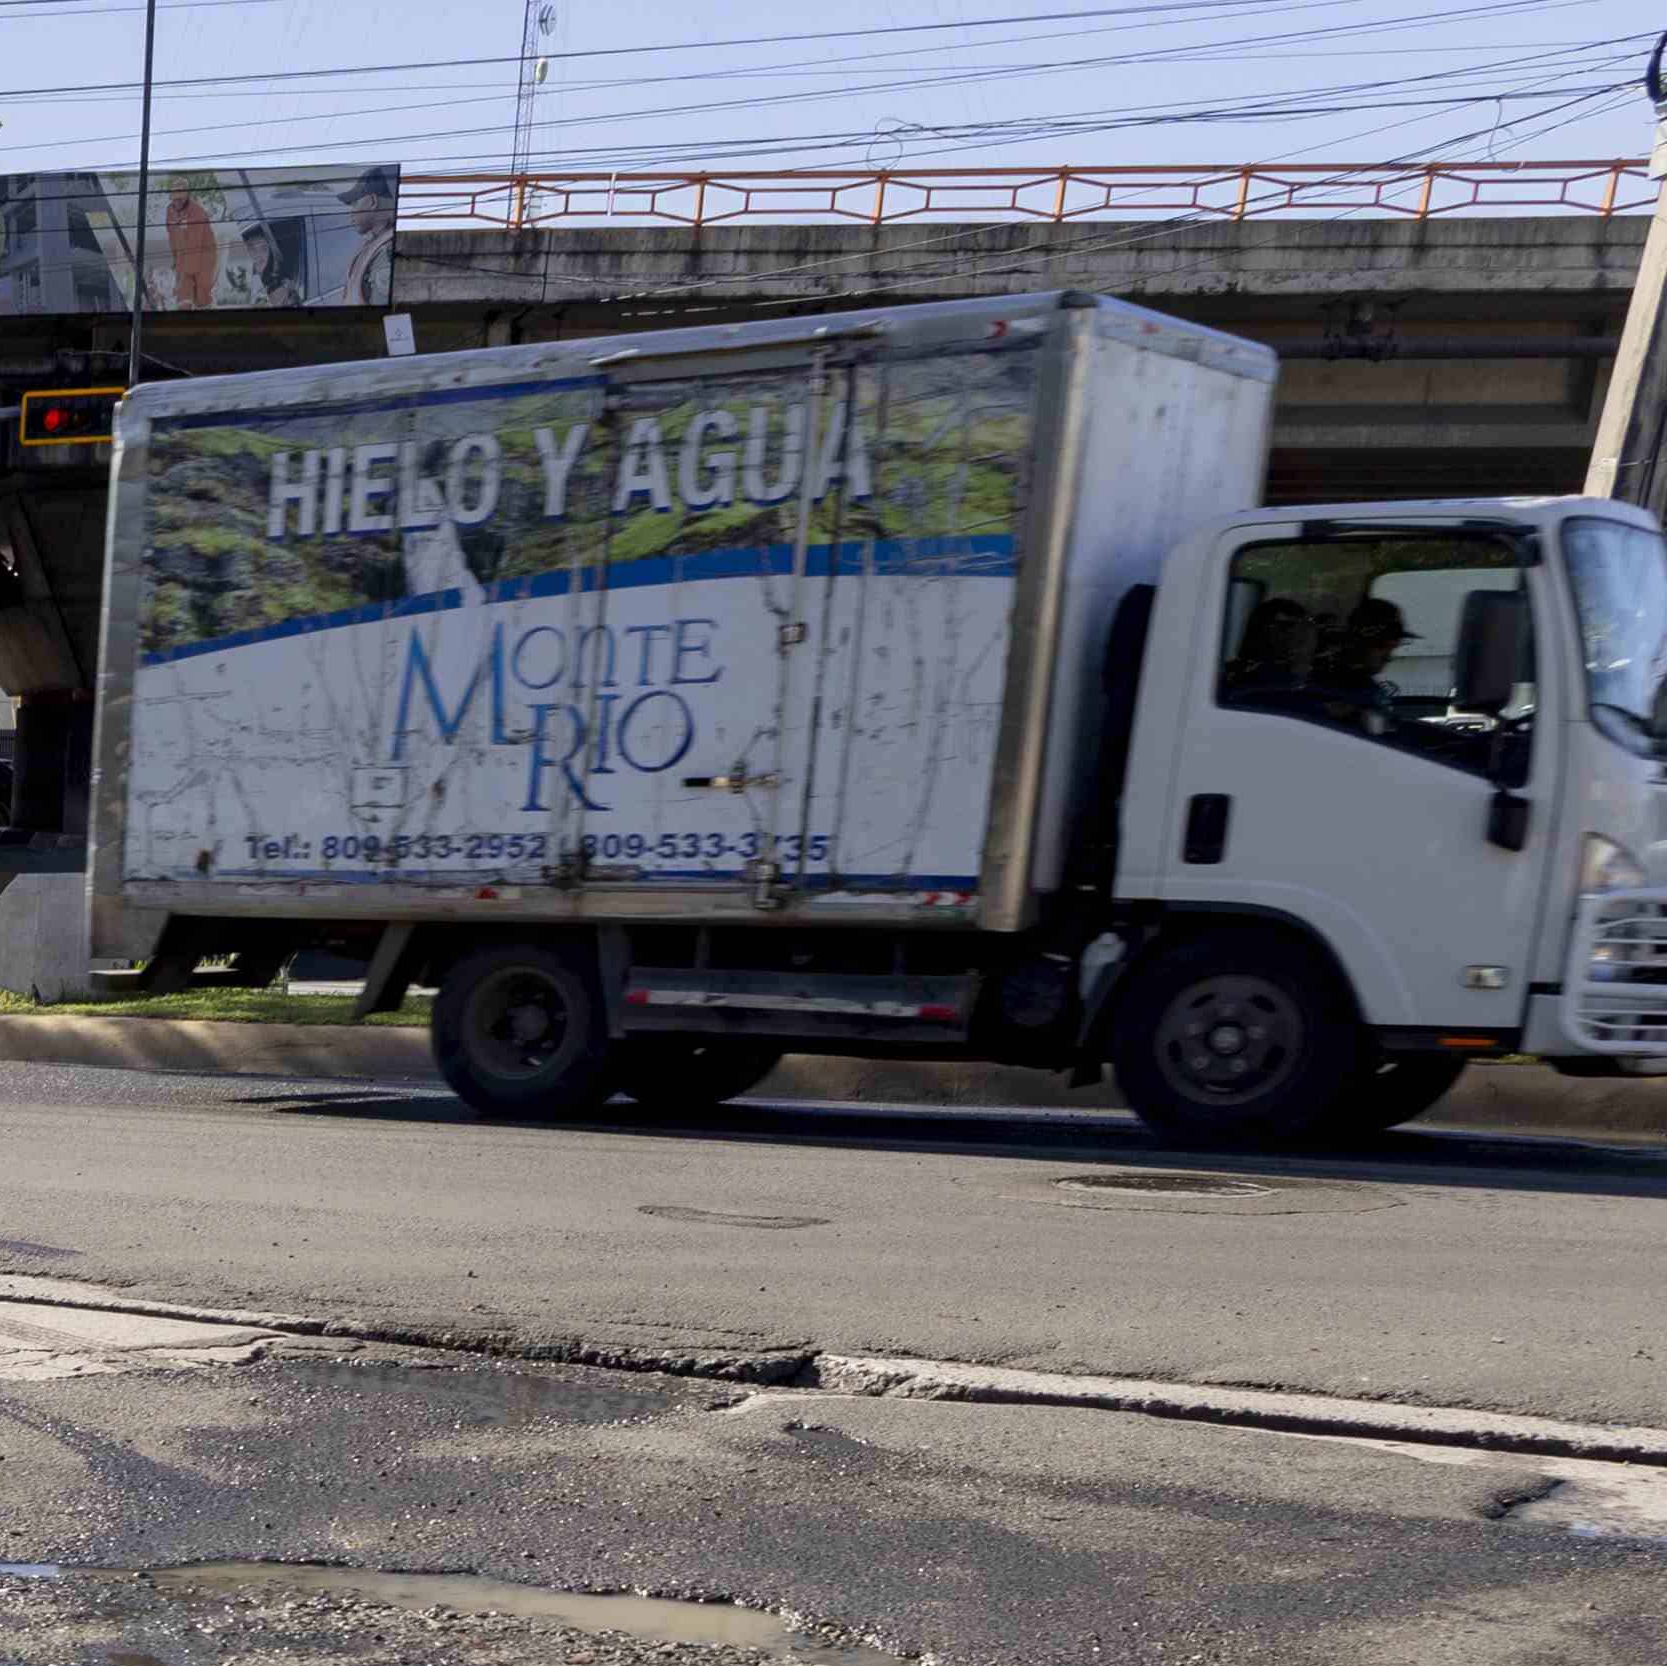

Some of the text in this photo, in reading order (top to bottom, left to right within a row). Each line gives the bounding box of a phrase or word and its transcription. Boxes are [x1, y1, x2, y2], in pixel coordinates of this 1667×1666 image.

[267, 402, 875, 542] HIELO Y AGUA
[520, 690, 694, 812] RIO
